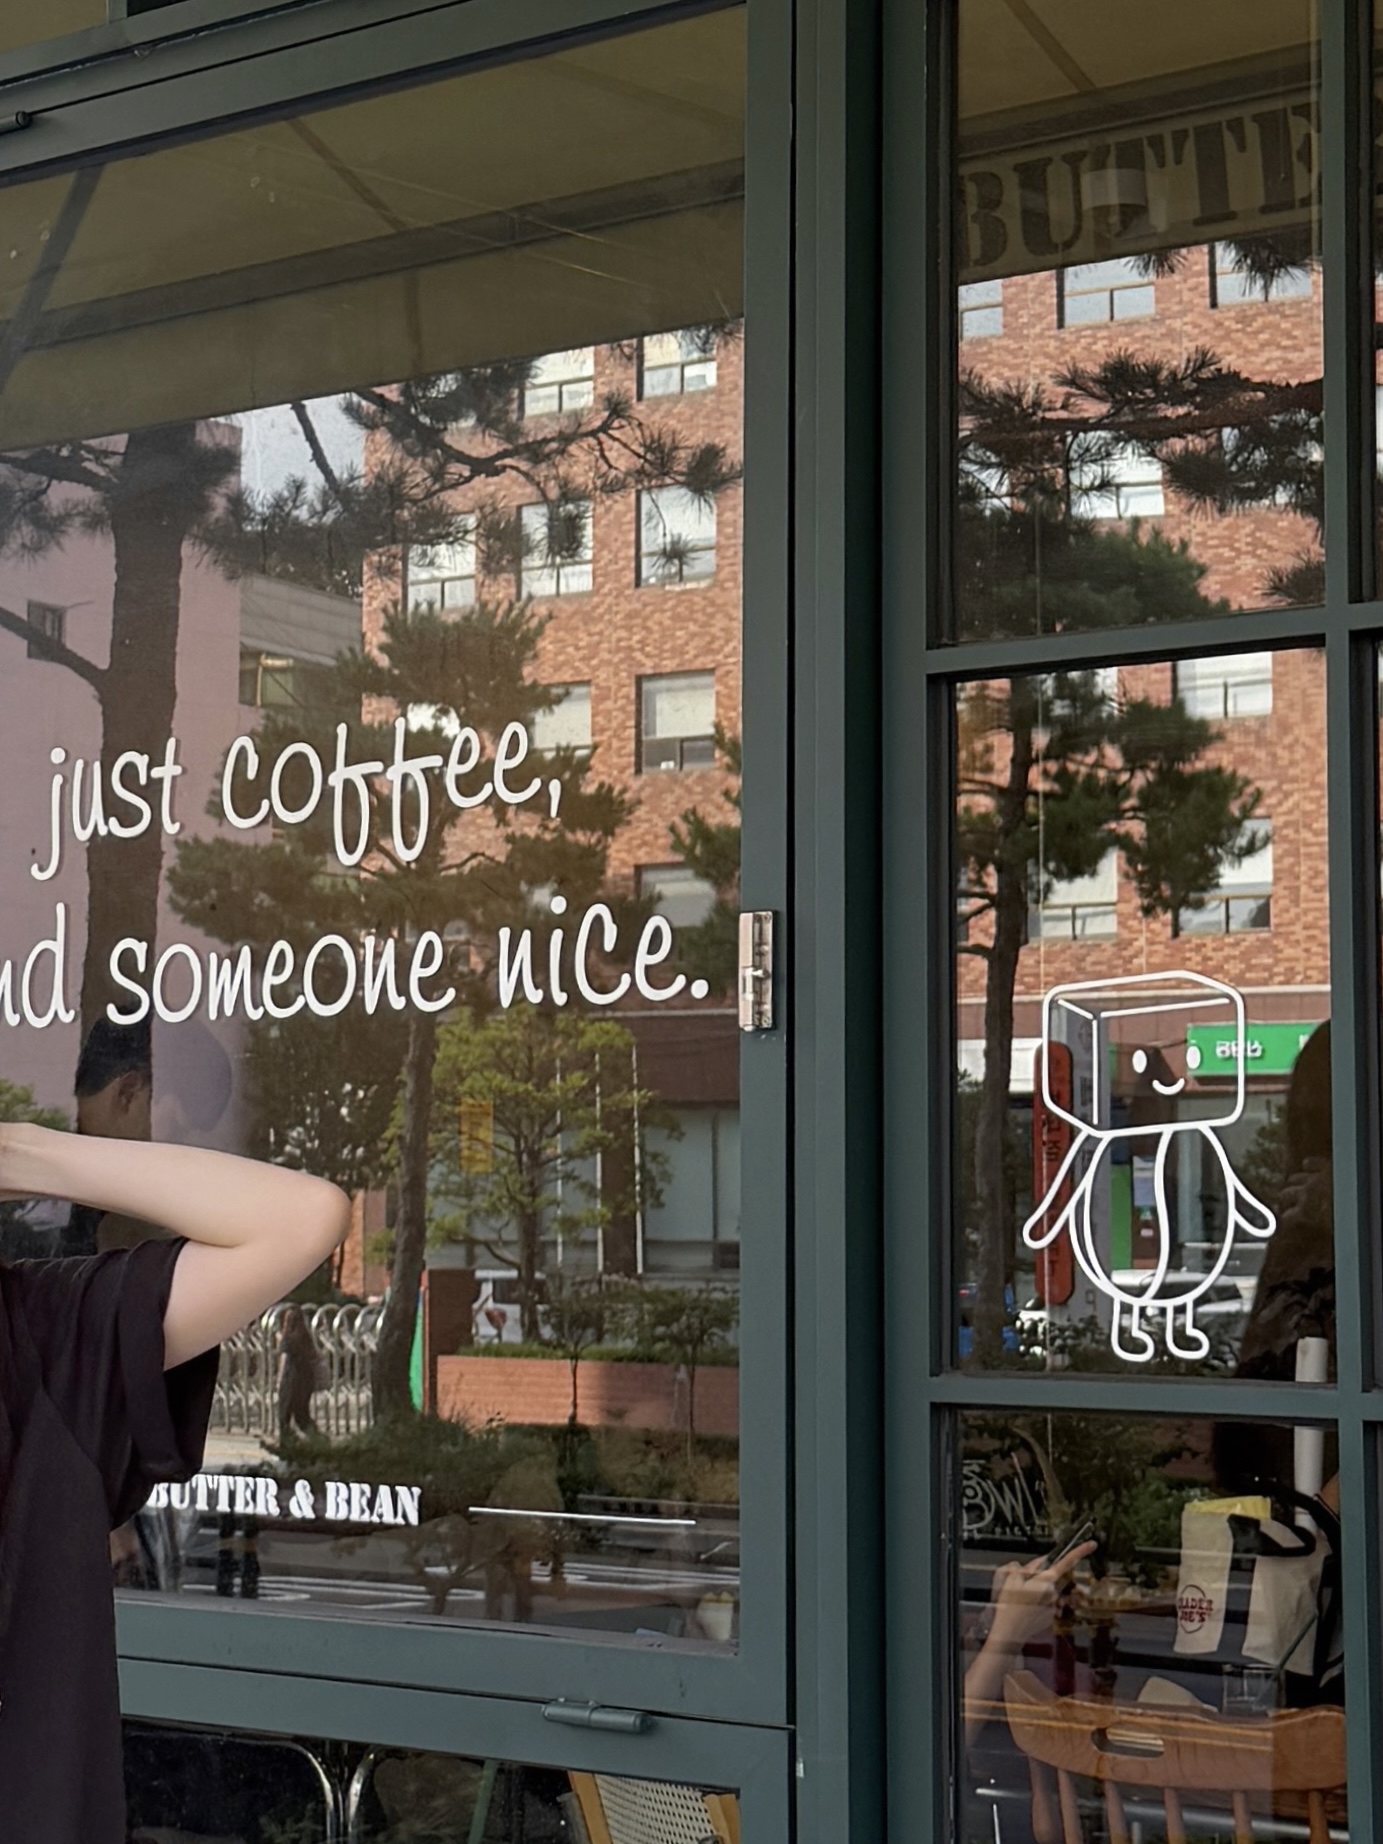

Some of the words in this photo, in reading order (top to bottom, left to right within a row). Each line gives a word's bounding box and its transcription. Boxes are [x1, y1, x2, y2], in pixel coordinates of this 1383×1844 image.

[30, 736, 181, 881] just
[222, 717, 562, 867] coffee,
[106, 929, 456, 1026] someone
[497, 895, 711, 1010] nice.
[288, 1478, 317, 1520] &
[323, 1480, 423, 1527] BEAN
